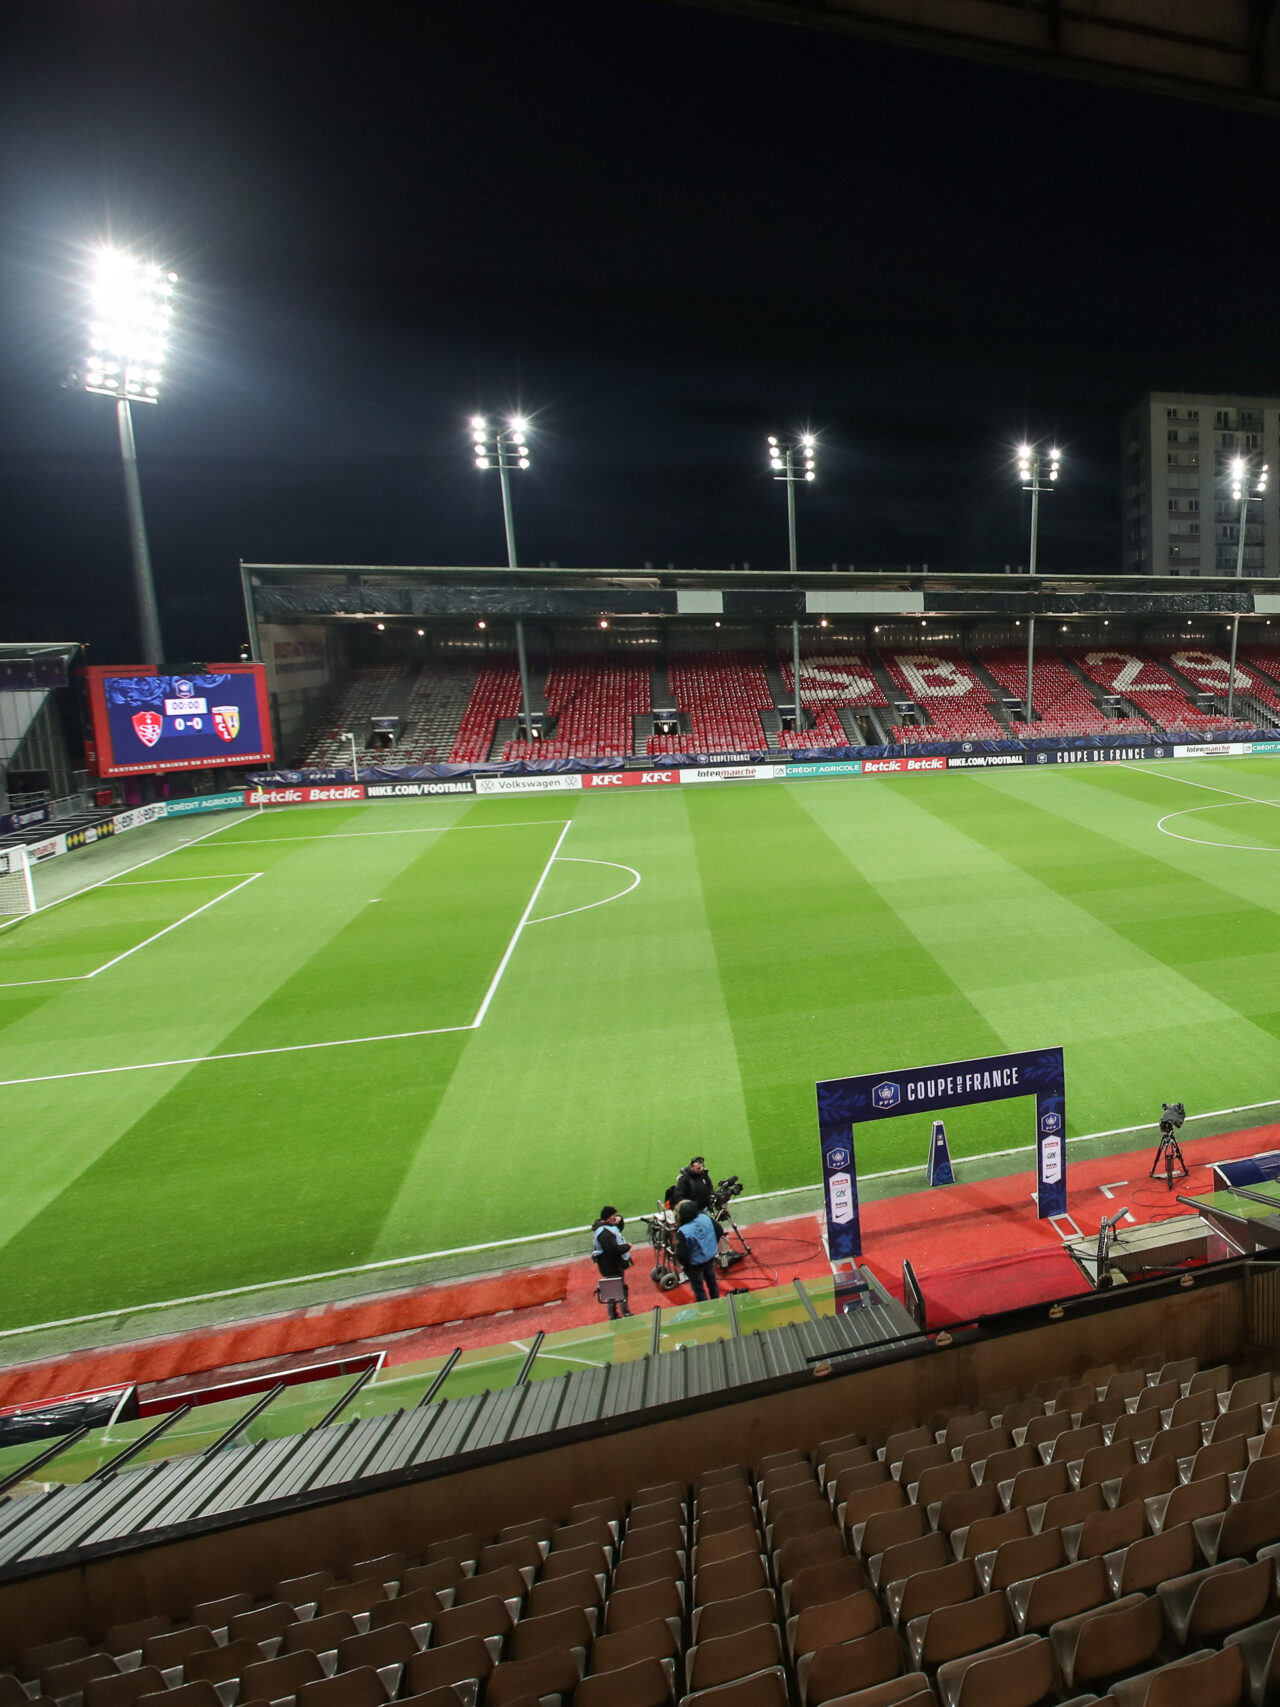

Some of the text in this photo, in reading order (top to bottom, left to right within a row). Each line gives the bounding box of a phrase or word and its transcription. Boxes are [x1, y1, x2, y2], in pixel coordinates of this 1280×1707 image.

[789, 651, 1253, 700] SB 29
[171, 701, 200, 710] 00:00
[1252, 742, 1275, 751] CRÉDIT
[948, 755, 1024, 767] NIKE.COM/FOOTBALL
[1057, 748, 1145, 763] COUPE DE FRANCE
[786, 764, 817, 774] CRÉDIT
[819, 763, 860, 773] AGRICOLE
[864, 760, 902, 772] Betclic
[907, 759, 943, 770] Betclic
[591, 774, 624, 786] KFC
[640, 772, 672, 783] KFC
[367, 781, 473, 797] NIKE.COM/FOOTBALL
[498, 778, 561, 790] Volkswagen
[250, 790, 303, 803] Betclic
[309, 787, 361, 800] Betclic
[167, 800, 199, 812] CRÉDIT
[201, 796, 244, 808] AGRICOLE
[907, 1077, 954, 1101] COUPE
[966, 1067, 1019, 1092] FRANCE
